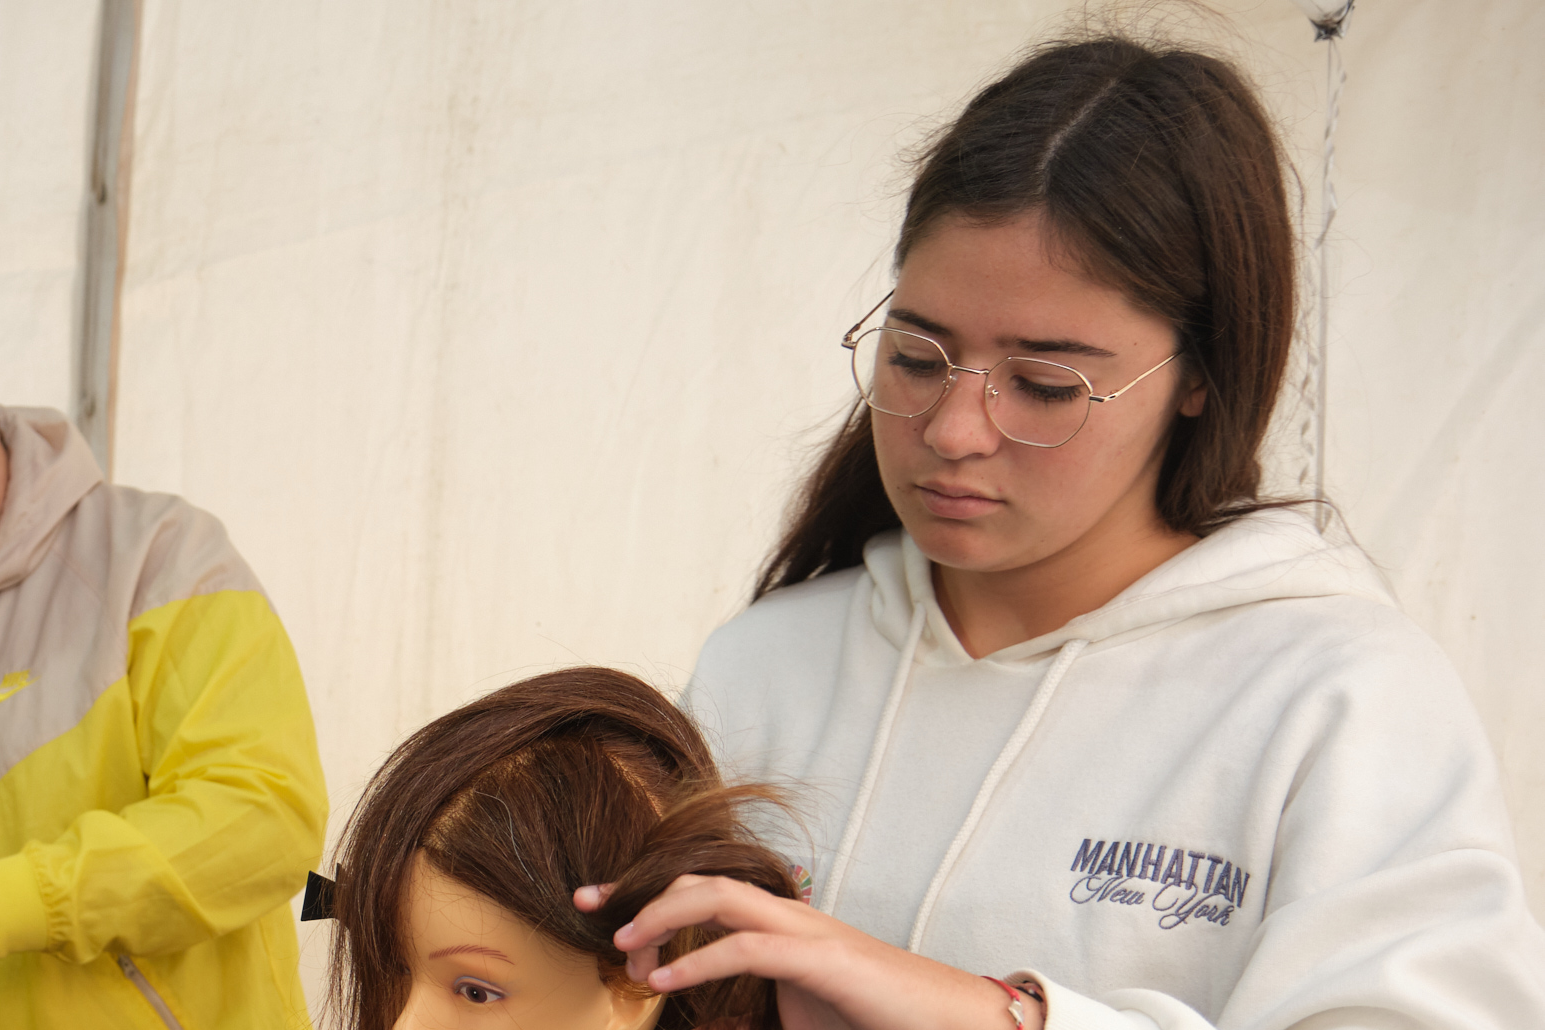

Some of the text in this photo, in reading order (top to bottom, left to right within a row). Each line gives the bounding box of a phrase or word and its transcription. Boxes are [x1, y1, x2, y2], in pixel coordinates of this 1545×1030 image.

[1069, 873, 1235, 929] New York
[1070, 838, 1250, 908] MANHATTAN
